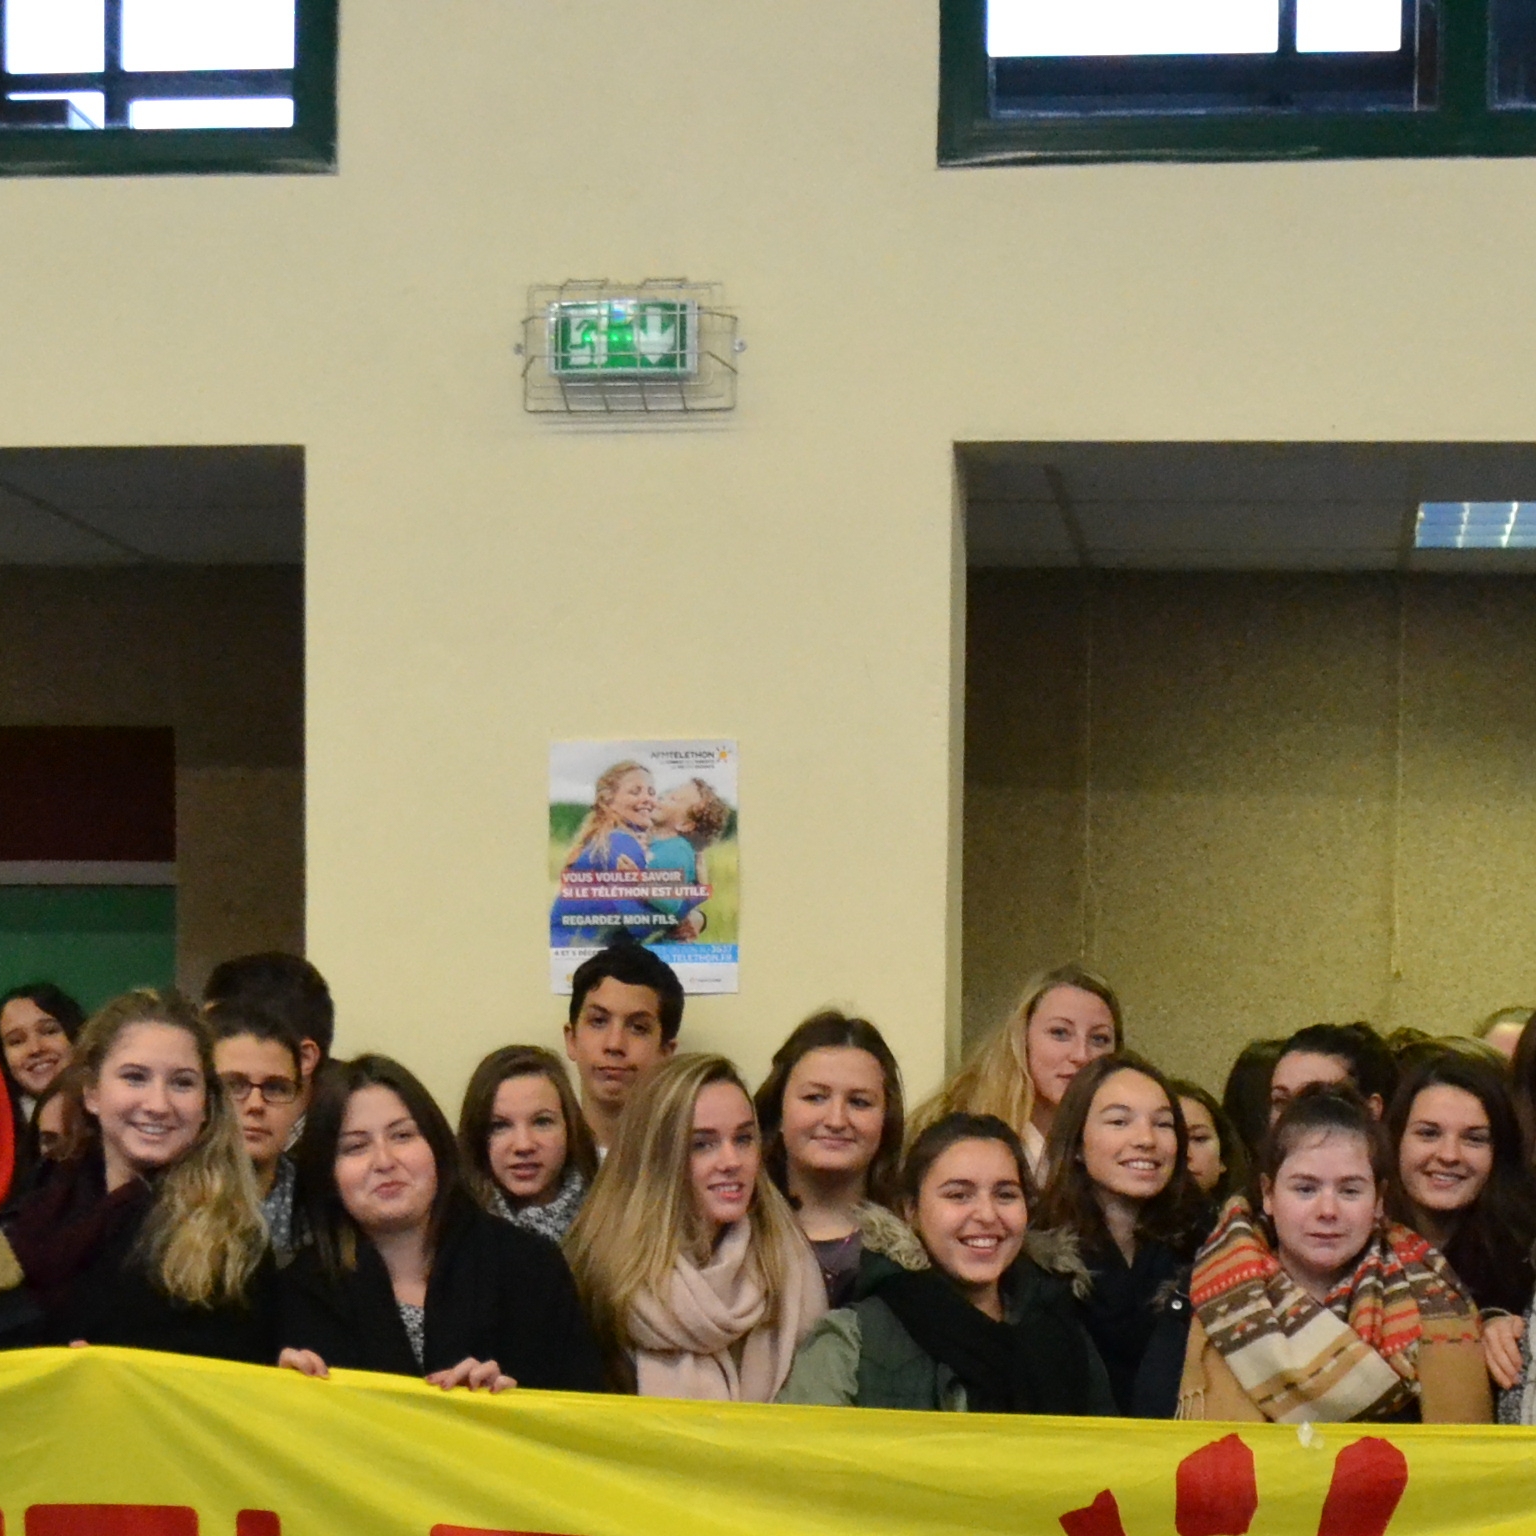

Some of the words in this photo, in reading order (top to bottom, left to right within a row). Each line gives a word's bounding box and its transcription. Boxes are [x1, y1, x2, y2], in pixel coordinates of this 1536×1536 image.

[562, 872, 593, 883] VOUS
[596, 872, 638, 883] VOULEZ
[642, 871, 681, 882] SAVOIR
[562, 887, 573, 898] SI
[576, 887, 589, 898] LE
[592, 885, 648, 898] TÉLÉTHON
[652, 887, 671, 897] EST
[562, 915, 621, 926] REGARDEZ
[623, 915, 650, 925] MON
